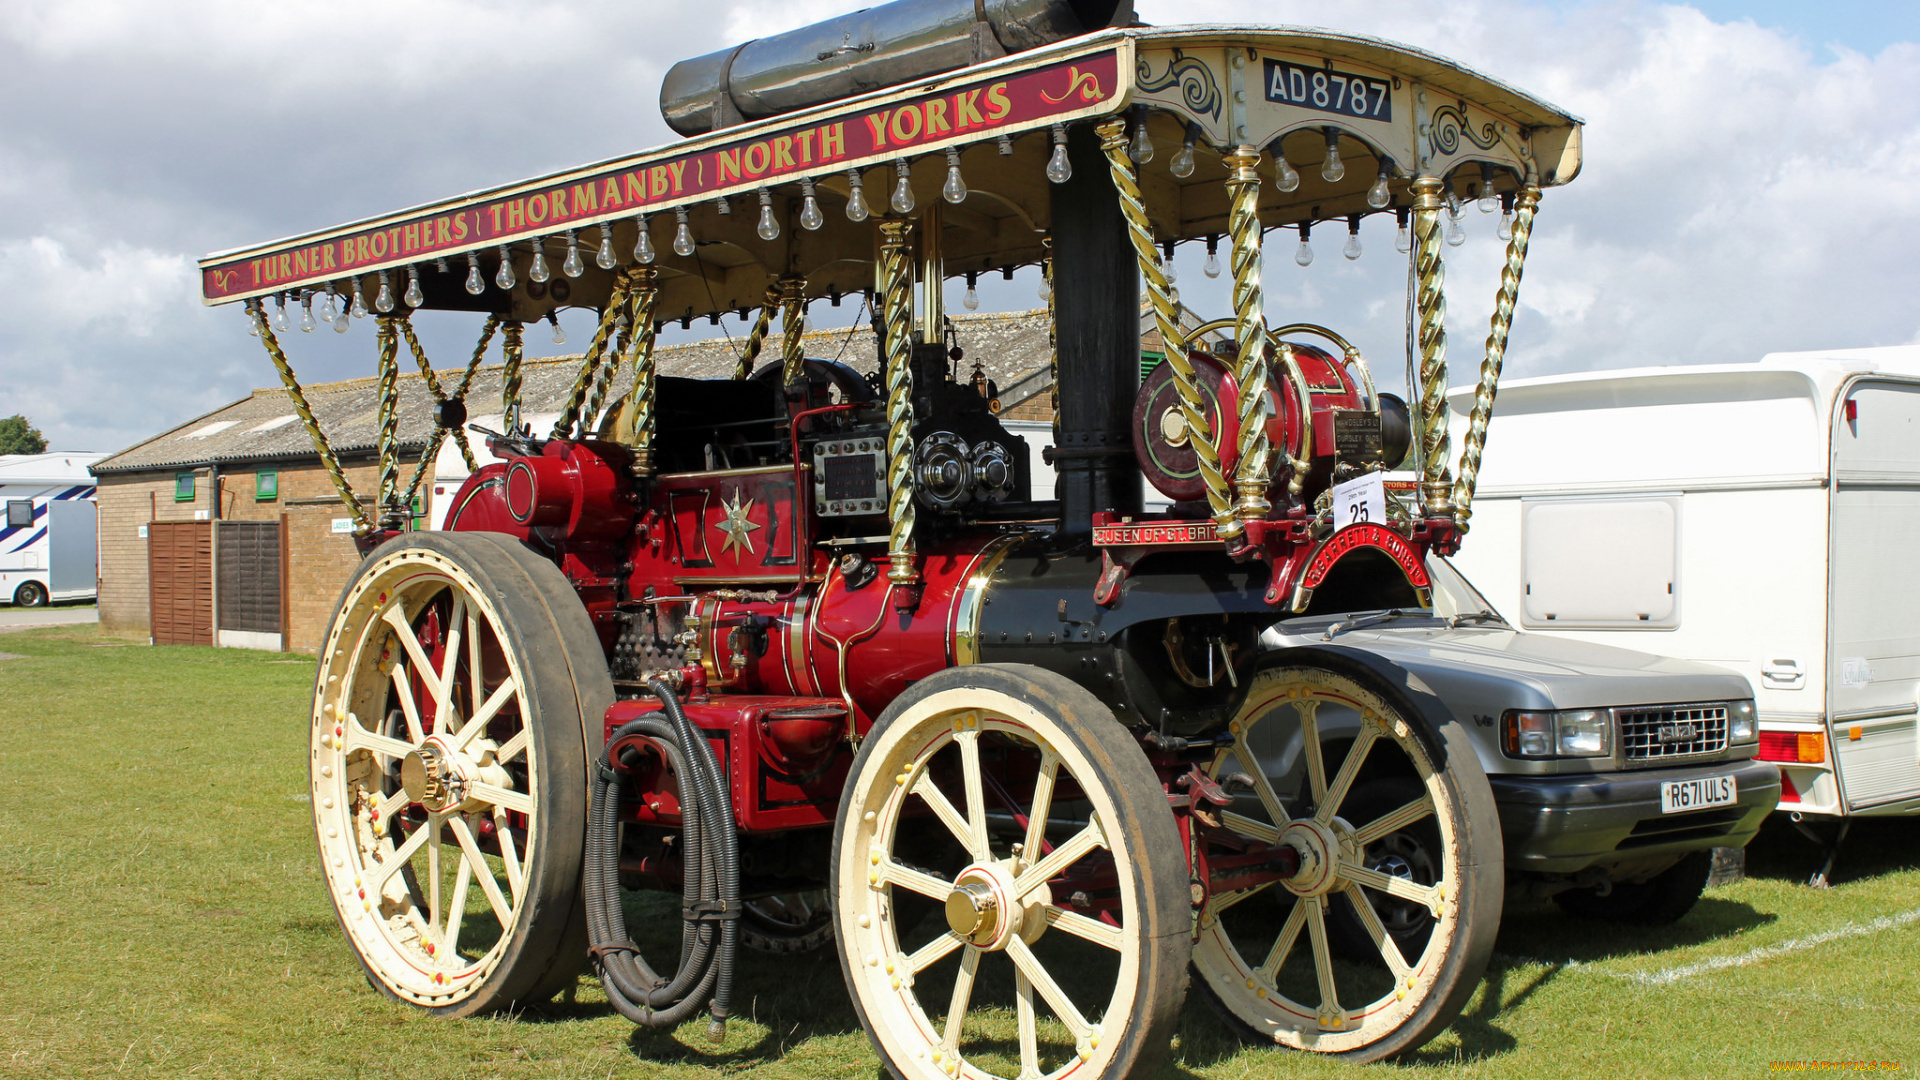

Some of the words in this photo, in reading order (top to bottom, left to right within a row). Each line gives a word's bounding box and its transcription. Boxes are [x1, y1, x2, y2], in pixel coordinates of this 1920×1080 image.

[1270, 64, 1386, 116] AD8787
[251, 245, 336, 284] TURNER
[342, 213, 468, 265] BROTHERS
[490, 162, 686, 232] THORMANBY
[719, 122, 845, 183] NORTH
[870, 82, 1012, 146] YORKS
[1350, 500, 1369, 523] 25
[1096, 529, 1140, 542] QUEEN
[1145, 529, 1161, 541] OF
[1188, 526, 1217, 540] BRIT
